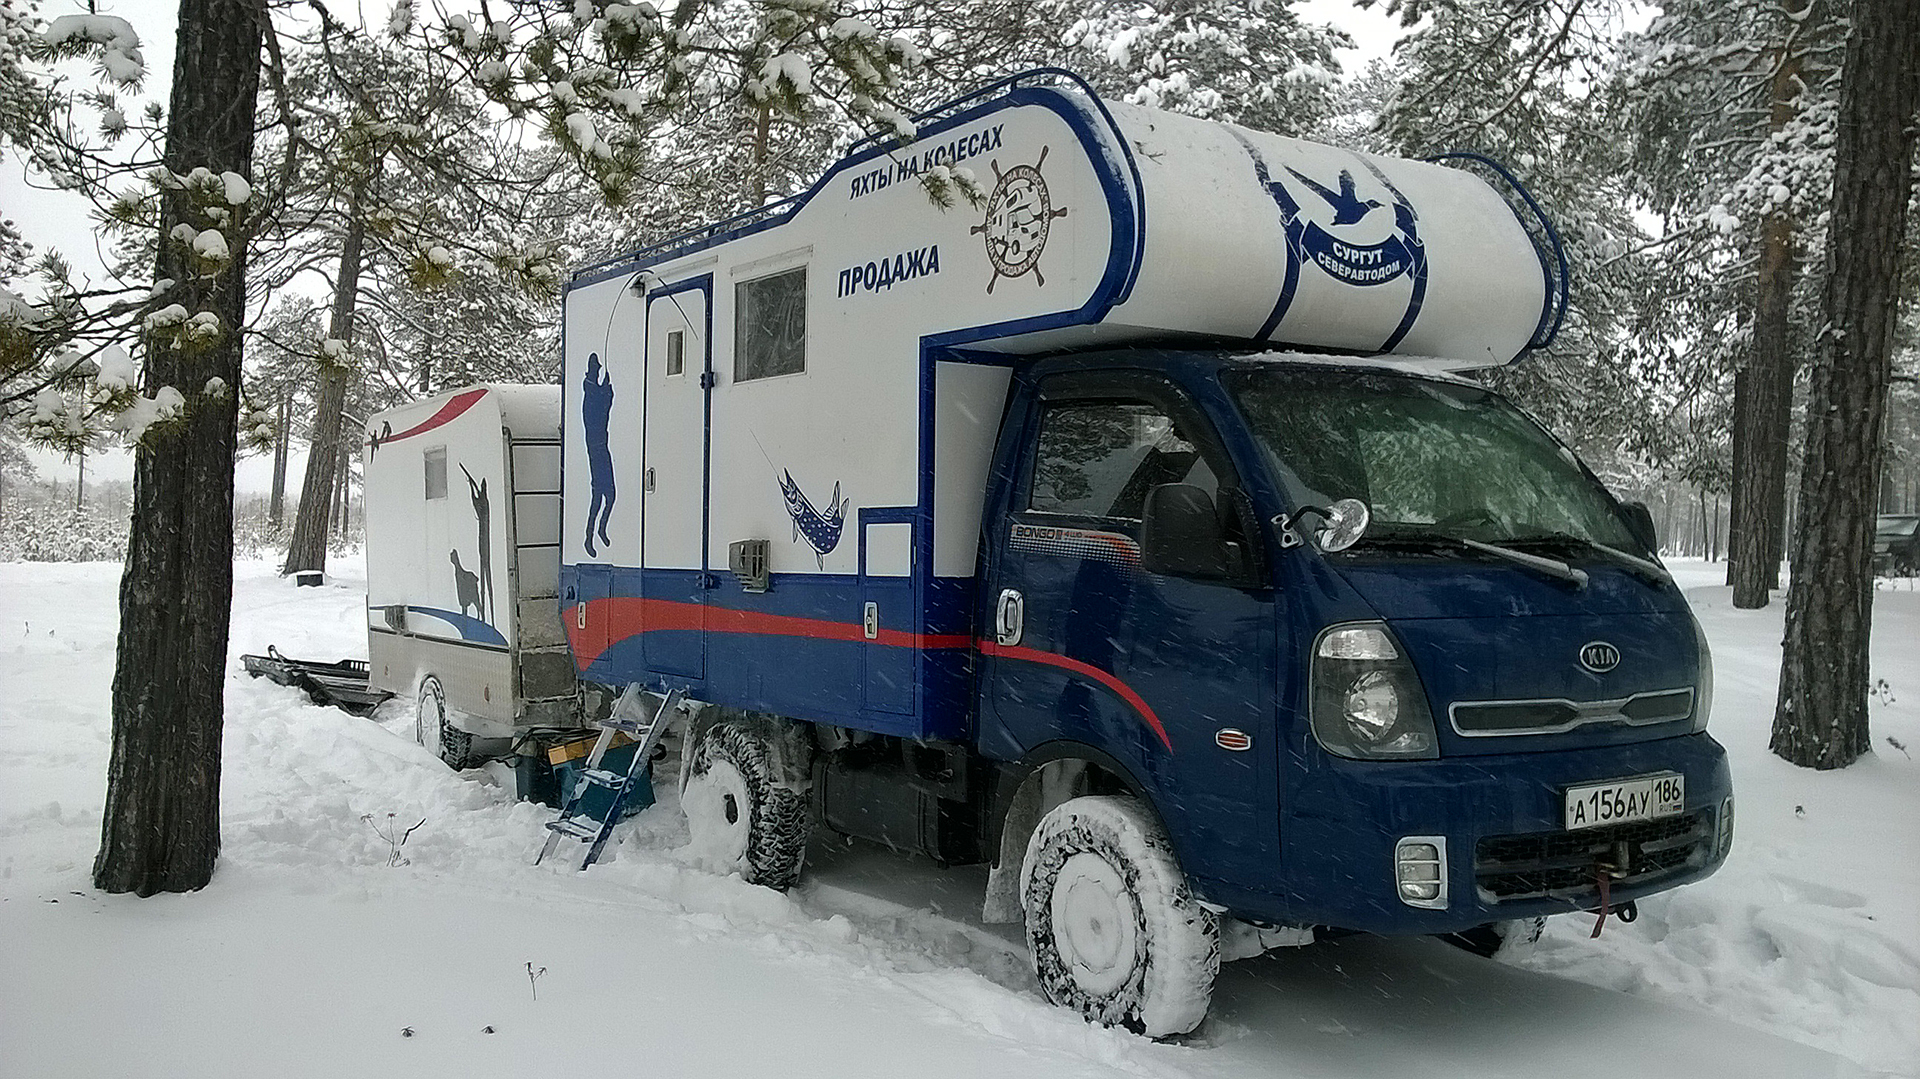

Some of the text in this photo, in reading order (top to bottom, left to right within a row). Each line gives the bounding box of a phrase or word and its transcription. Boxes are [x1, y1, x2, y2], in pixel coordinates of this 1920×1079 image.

[850, 123, 1005, 200] ЯХТЫ НА КОЛЕСАХ
[1317, 251, 1400, 281] СЕВЕРАВТОДОМ
[1332, 241, 1384, 265] СУРГУТ
[837, 244, 940, 298] ПРОДАЖА
[1016, 525, 1055, 540] BONGO
[1587, 648, 1615, 665] KIA
[1654, 778, 1681, 804] 186
